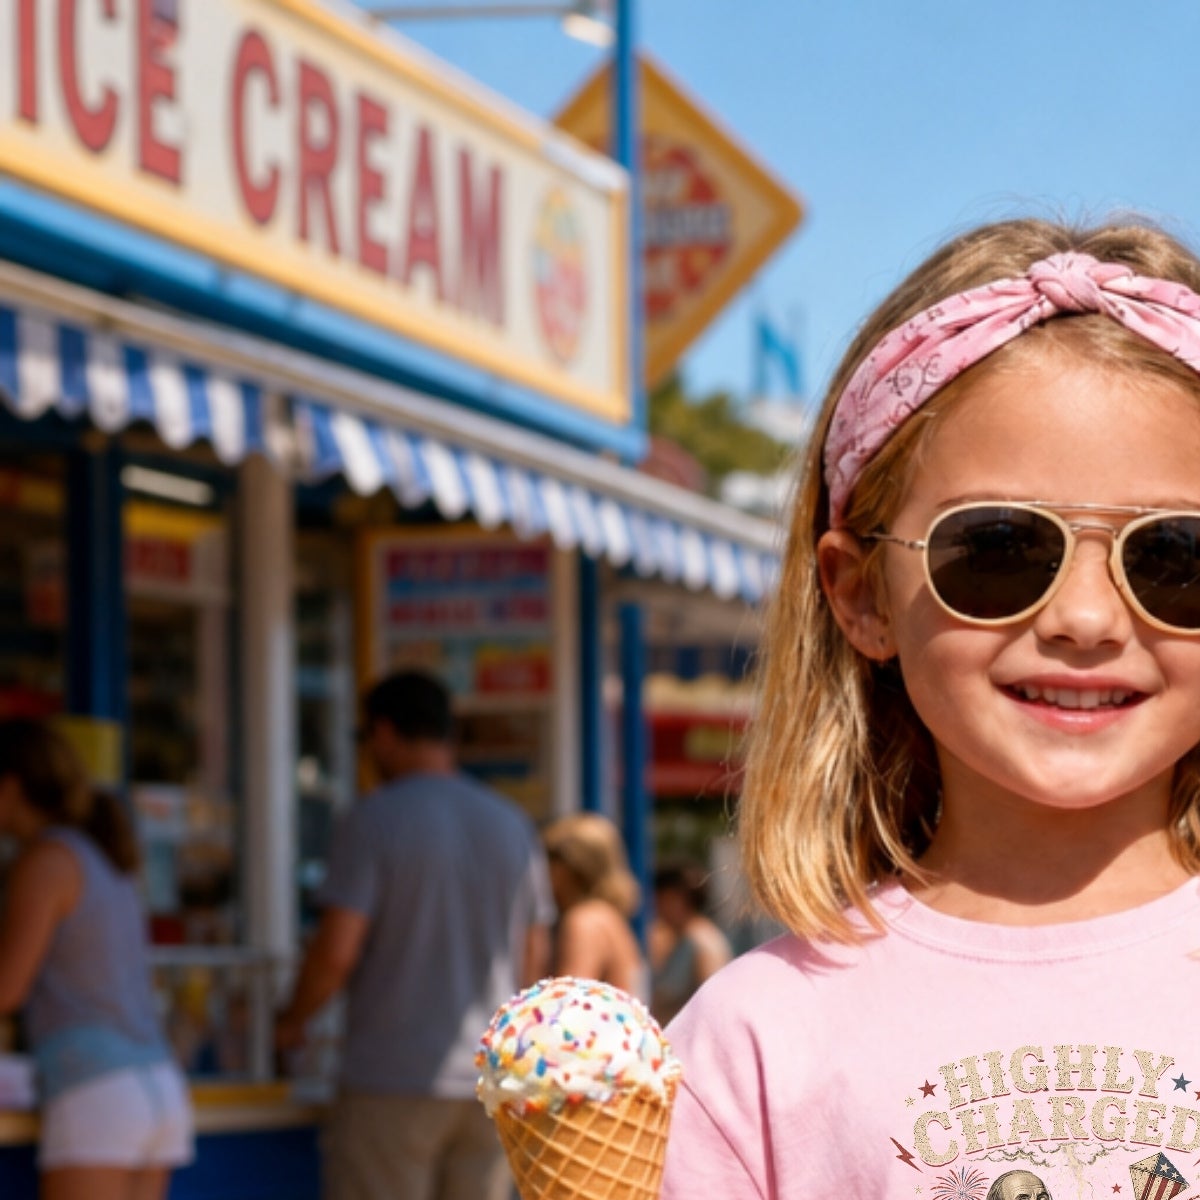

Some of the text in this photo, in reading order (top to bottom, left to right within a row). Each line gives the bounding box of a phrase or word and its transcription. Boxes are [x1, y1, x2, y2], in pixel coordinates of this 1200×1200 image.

[17, 0, 504, 330] ICE CREAM
[938, 1045, 1175, 1110] HIGHLY
